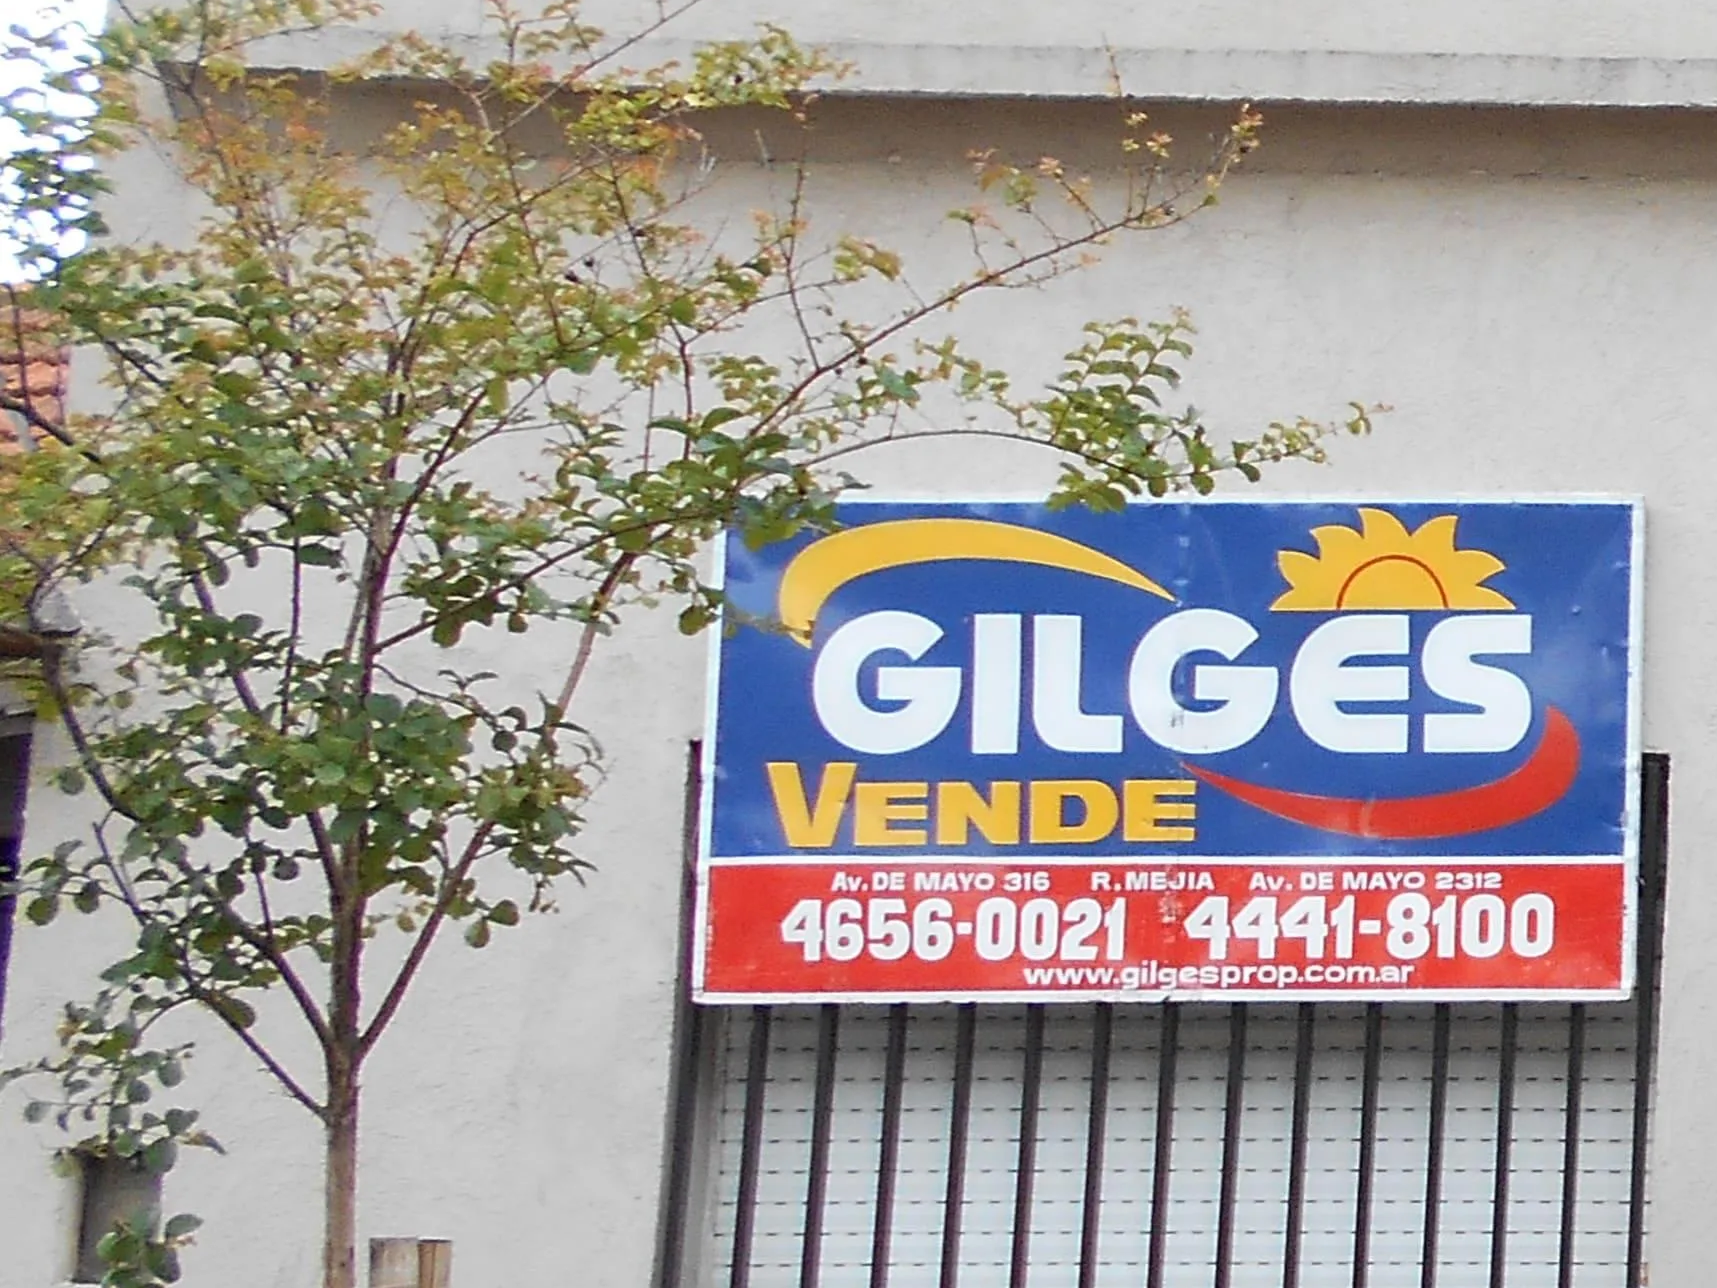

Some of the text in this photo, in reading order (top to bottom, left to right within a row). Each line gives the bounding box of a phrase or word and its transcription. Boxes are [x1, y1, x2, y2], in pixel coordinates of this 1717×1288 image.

[811, 608, 1533, 756] GILGES
[764, 761, 1198, 849] VENDE
[913, 871, 996, 892] MAYO
[1003, 870, 1050, 892] 316
[1248, 871, 1293, 891] Av.
[1301, 871, 1334, 891] DE
[1342, 871, 1426, 891] MAYO
[1434, 871, 1503, 890] 2312
[780, 892, 1556, 963] 4656-0021 4441-8100
[1023, 960, 1415, 989] www.gilgesprop.com.ar
